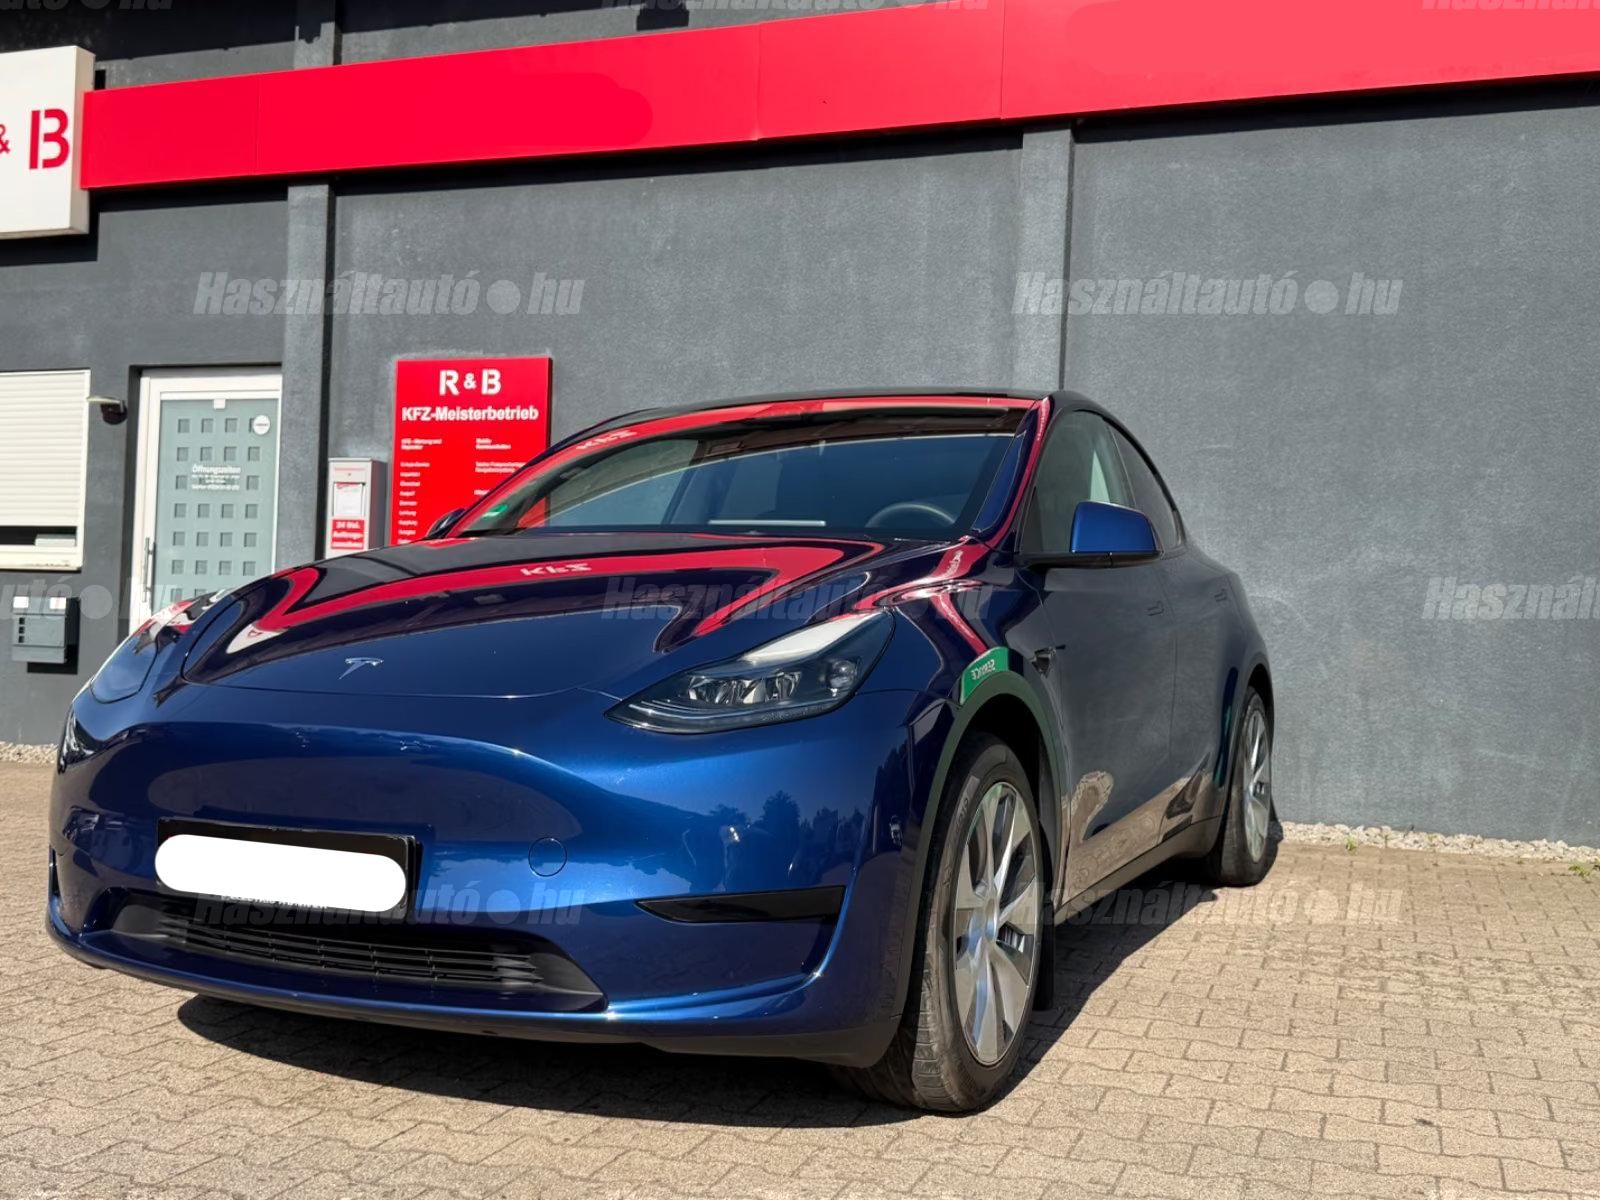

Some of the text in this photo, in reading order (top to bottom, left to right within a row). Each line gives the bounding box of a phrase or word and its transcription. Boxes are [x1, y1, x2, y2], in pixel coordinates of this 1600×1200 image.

[29, 108, 70, 170] B
[439, 368, 502, 396] R & B
[401, 405, 539, 421] KFZ-Meisterbetrieb
